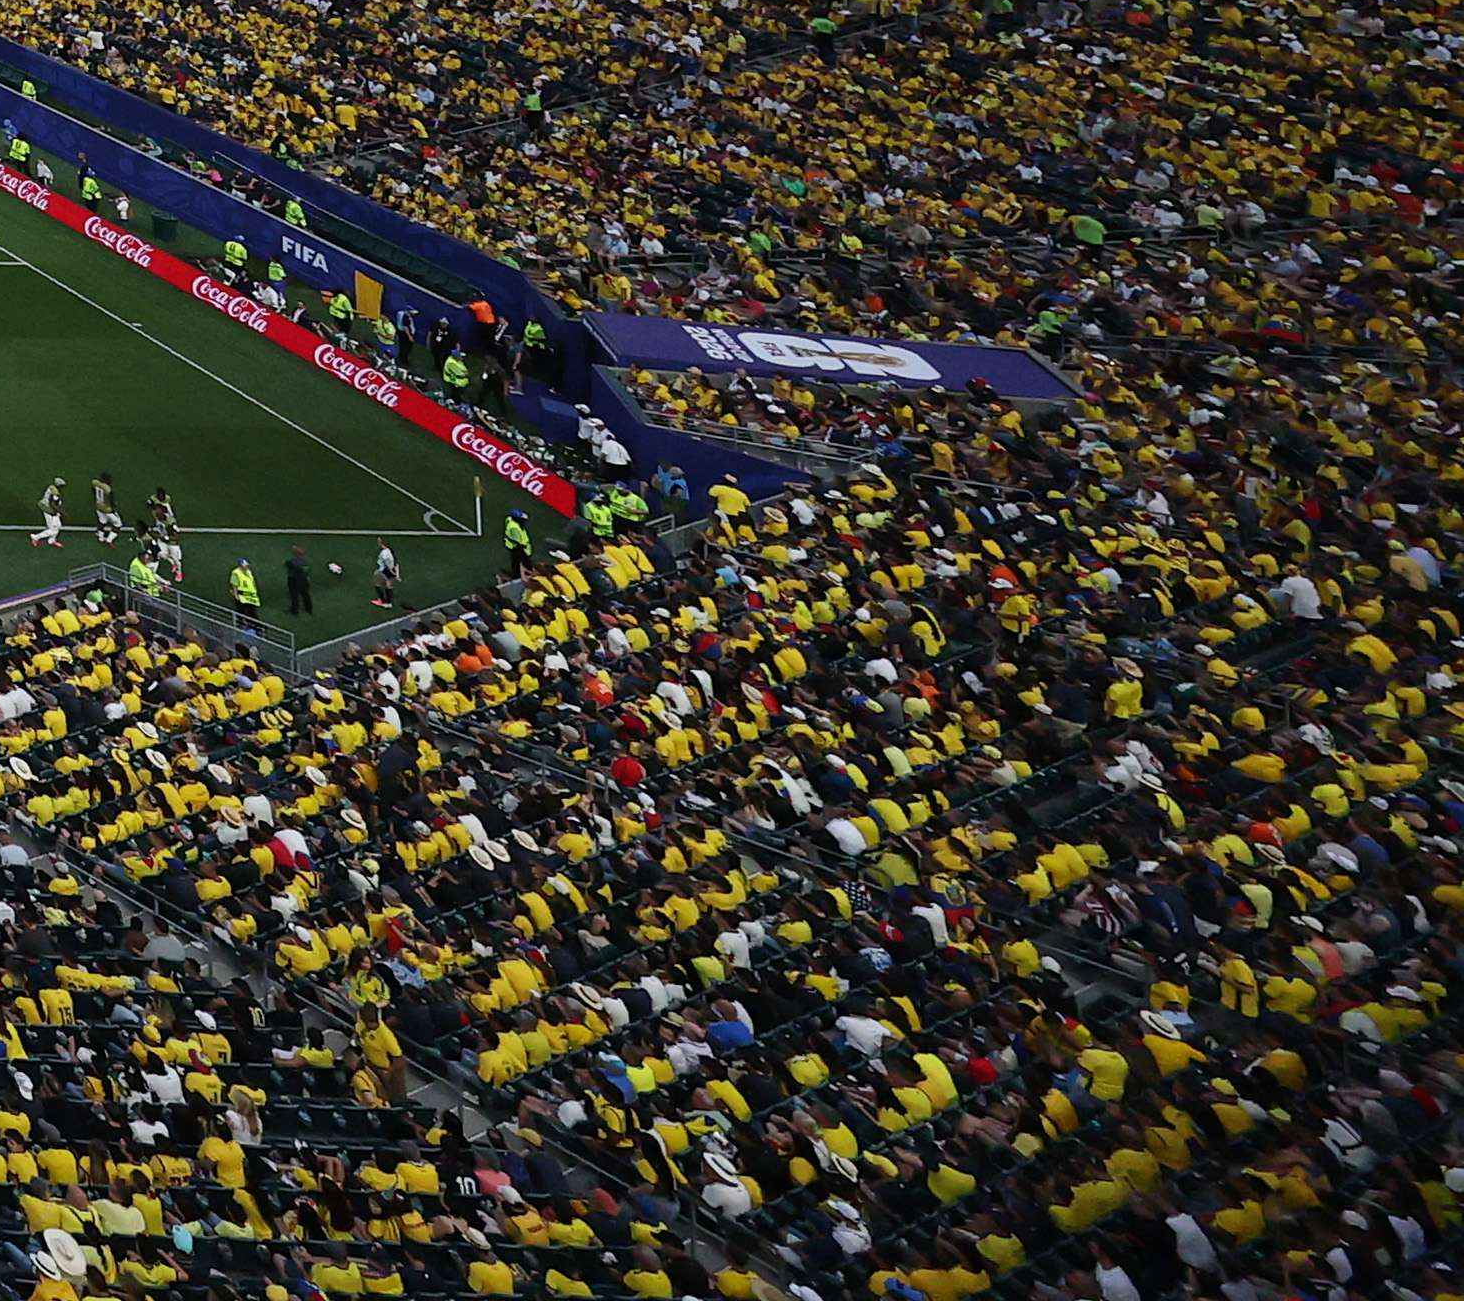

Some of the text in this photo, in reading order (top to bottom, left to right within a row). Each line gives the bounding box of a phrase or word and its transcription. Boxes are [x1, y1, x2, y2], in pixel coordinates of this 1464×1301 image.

[83, 215, 152, 270] Coca-Cola
[281, 235, 329, 273] FIFA
[191, 274, 268, 333] Coca-Cola
[314, 343, 399, 408] Coca-Cola
[451, 422, 545, 497] Coca-Cola
